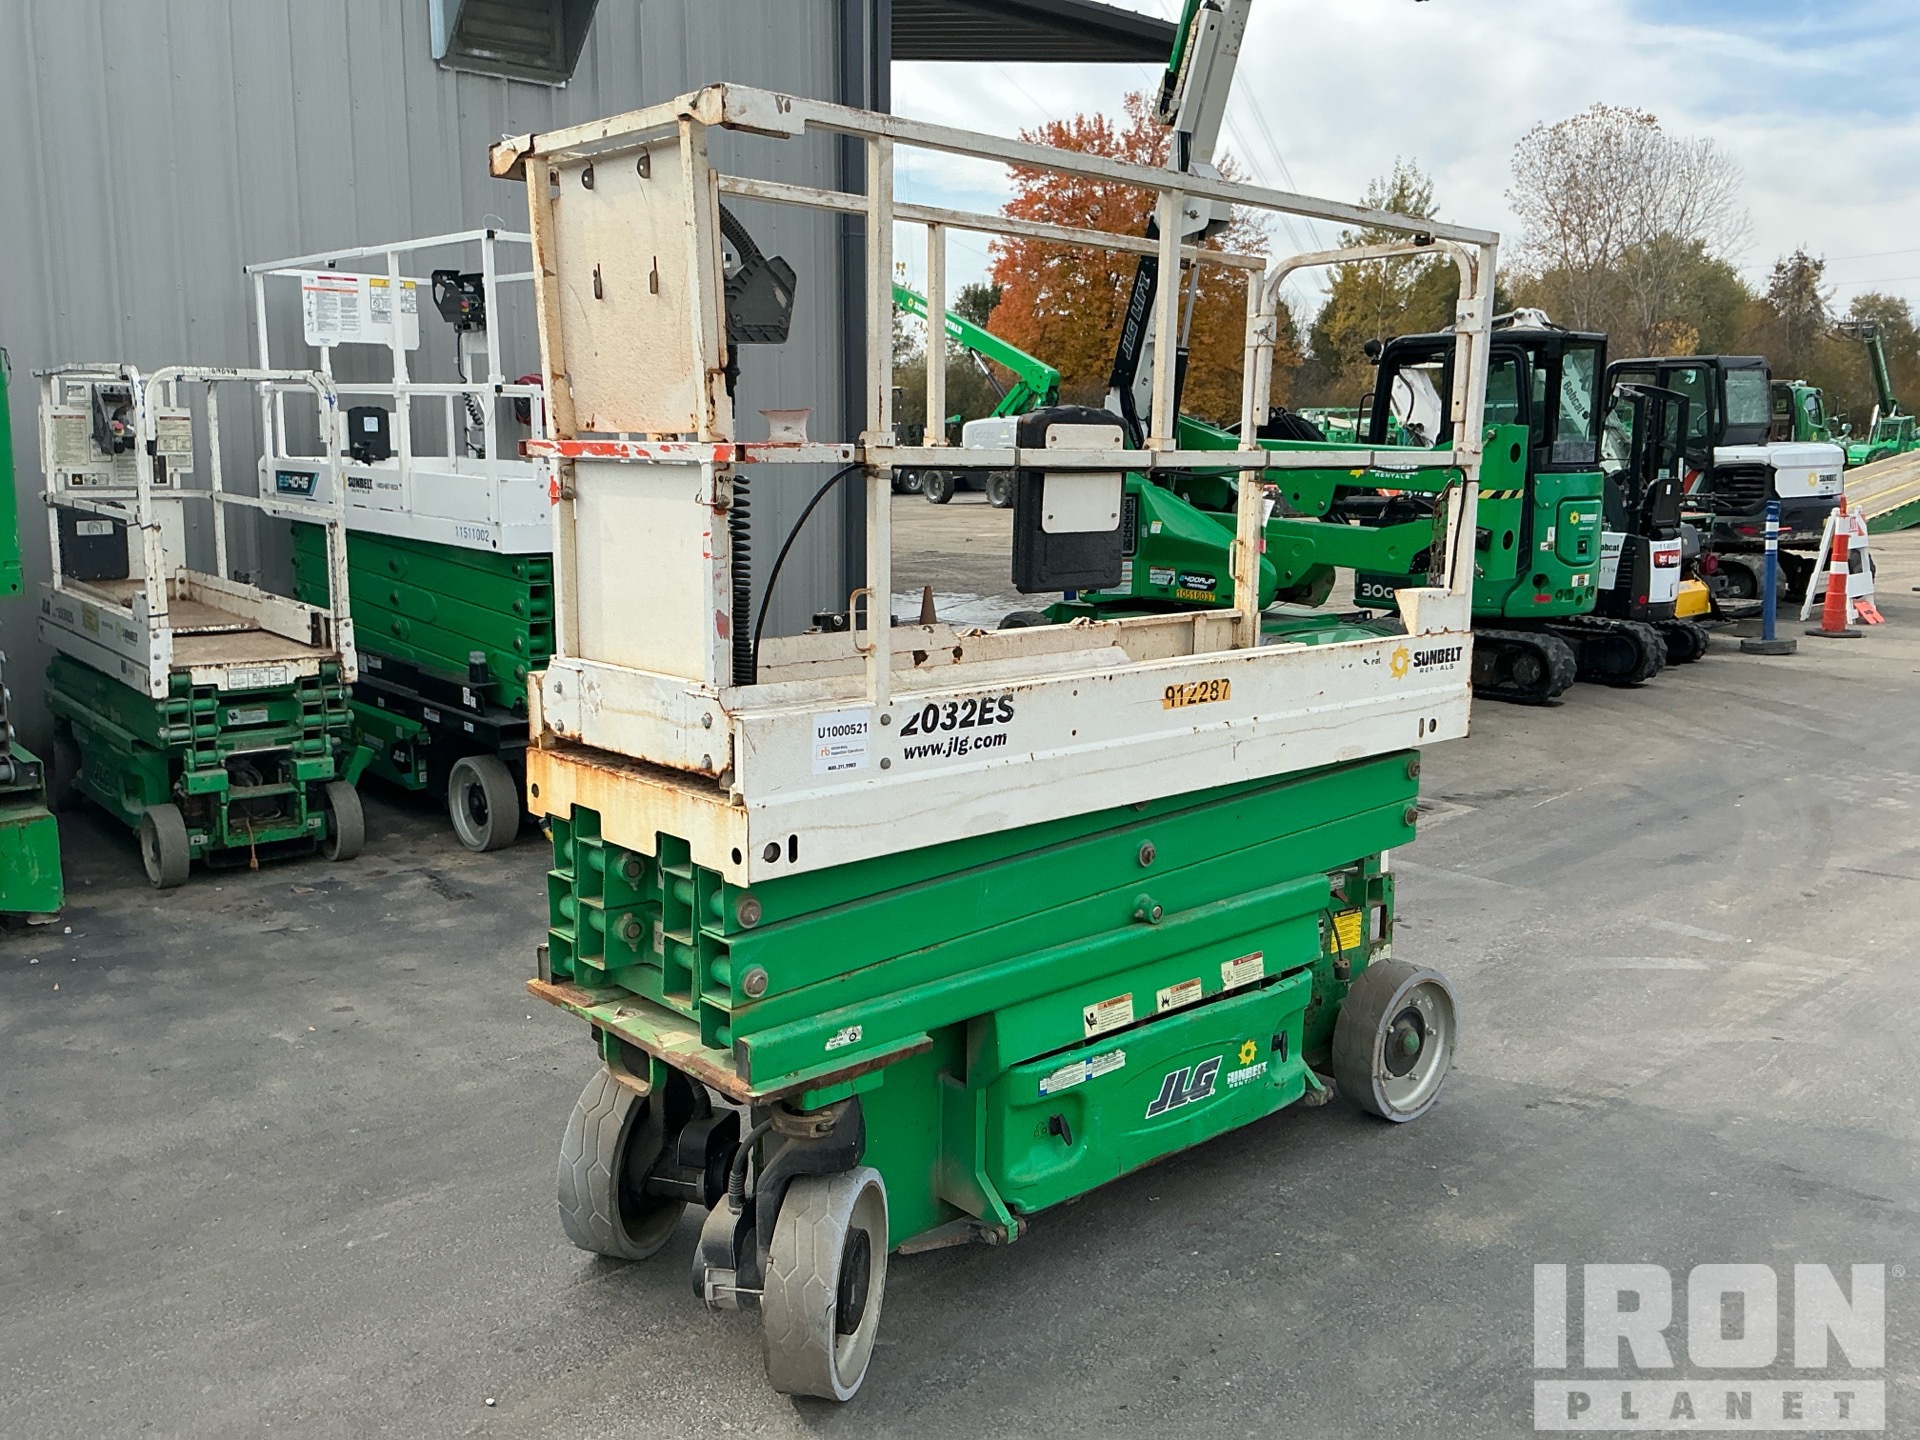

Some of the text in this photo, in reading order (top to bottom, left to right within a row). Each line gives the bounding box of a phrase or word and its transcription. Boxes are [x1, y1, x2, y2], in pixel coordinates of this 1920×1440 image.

[1121, 270, 1151, 361] JLG LIFT
[1563, 380, 1585, 415] Bobcat
[347, 476, 373, 490] SUNBELT
[1374, 471, 1411, 480] RENTALS
[455, 525, 490, 542] 11511002
[1600, 543, 1620, 552] obcat
[1361, 582, 1395, 599] 30G
[1412, 645, 1463, 668] SUNBELT
[1418, 662, 1455, 674] RENALS
[1164, 677, 1231, 708] 912287
[899, 692, 1015, 737] 2032ES
[817, 722, 868, 739] U1000521
[903, 733, 1008, 761] www.jlg.com
[1144, 1054, 1223, 1119] JLG
